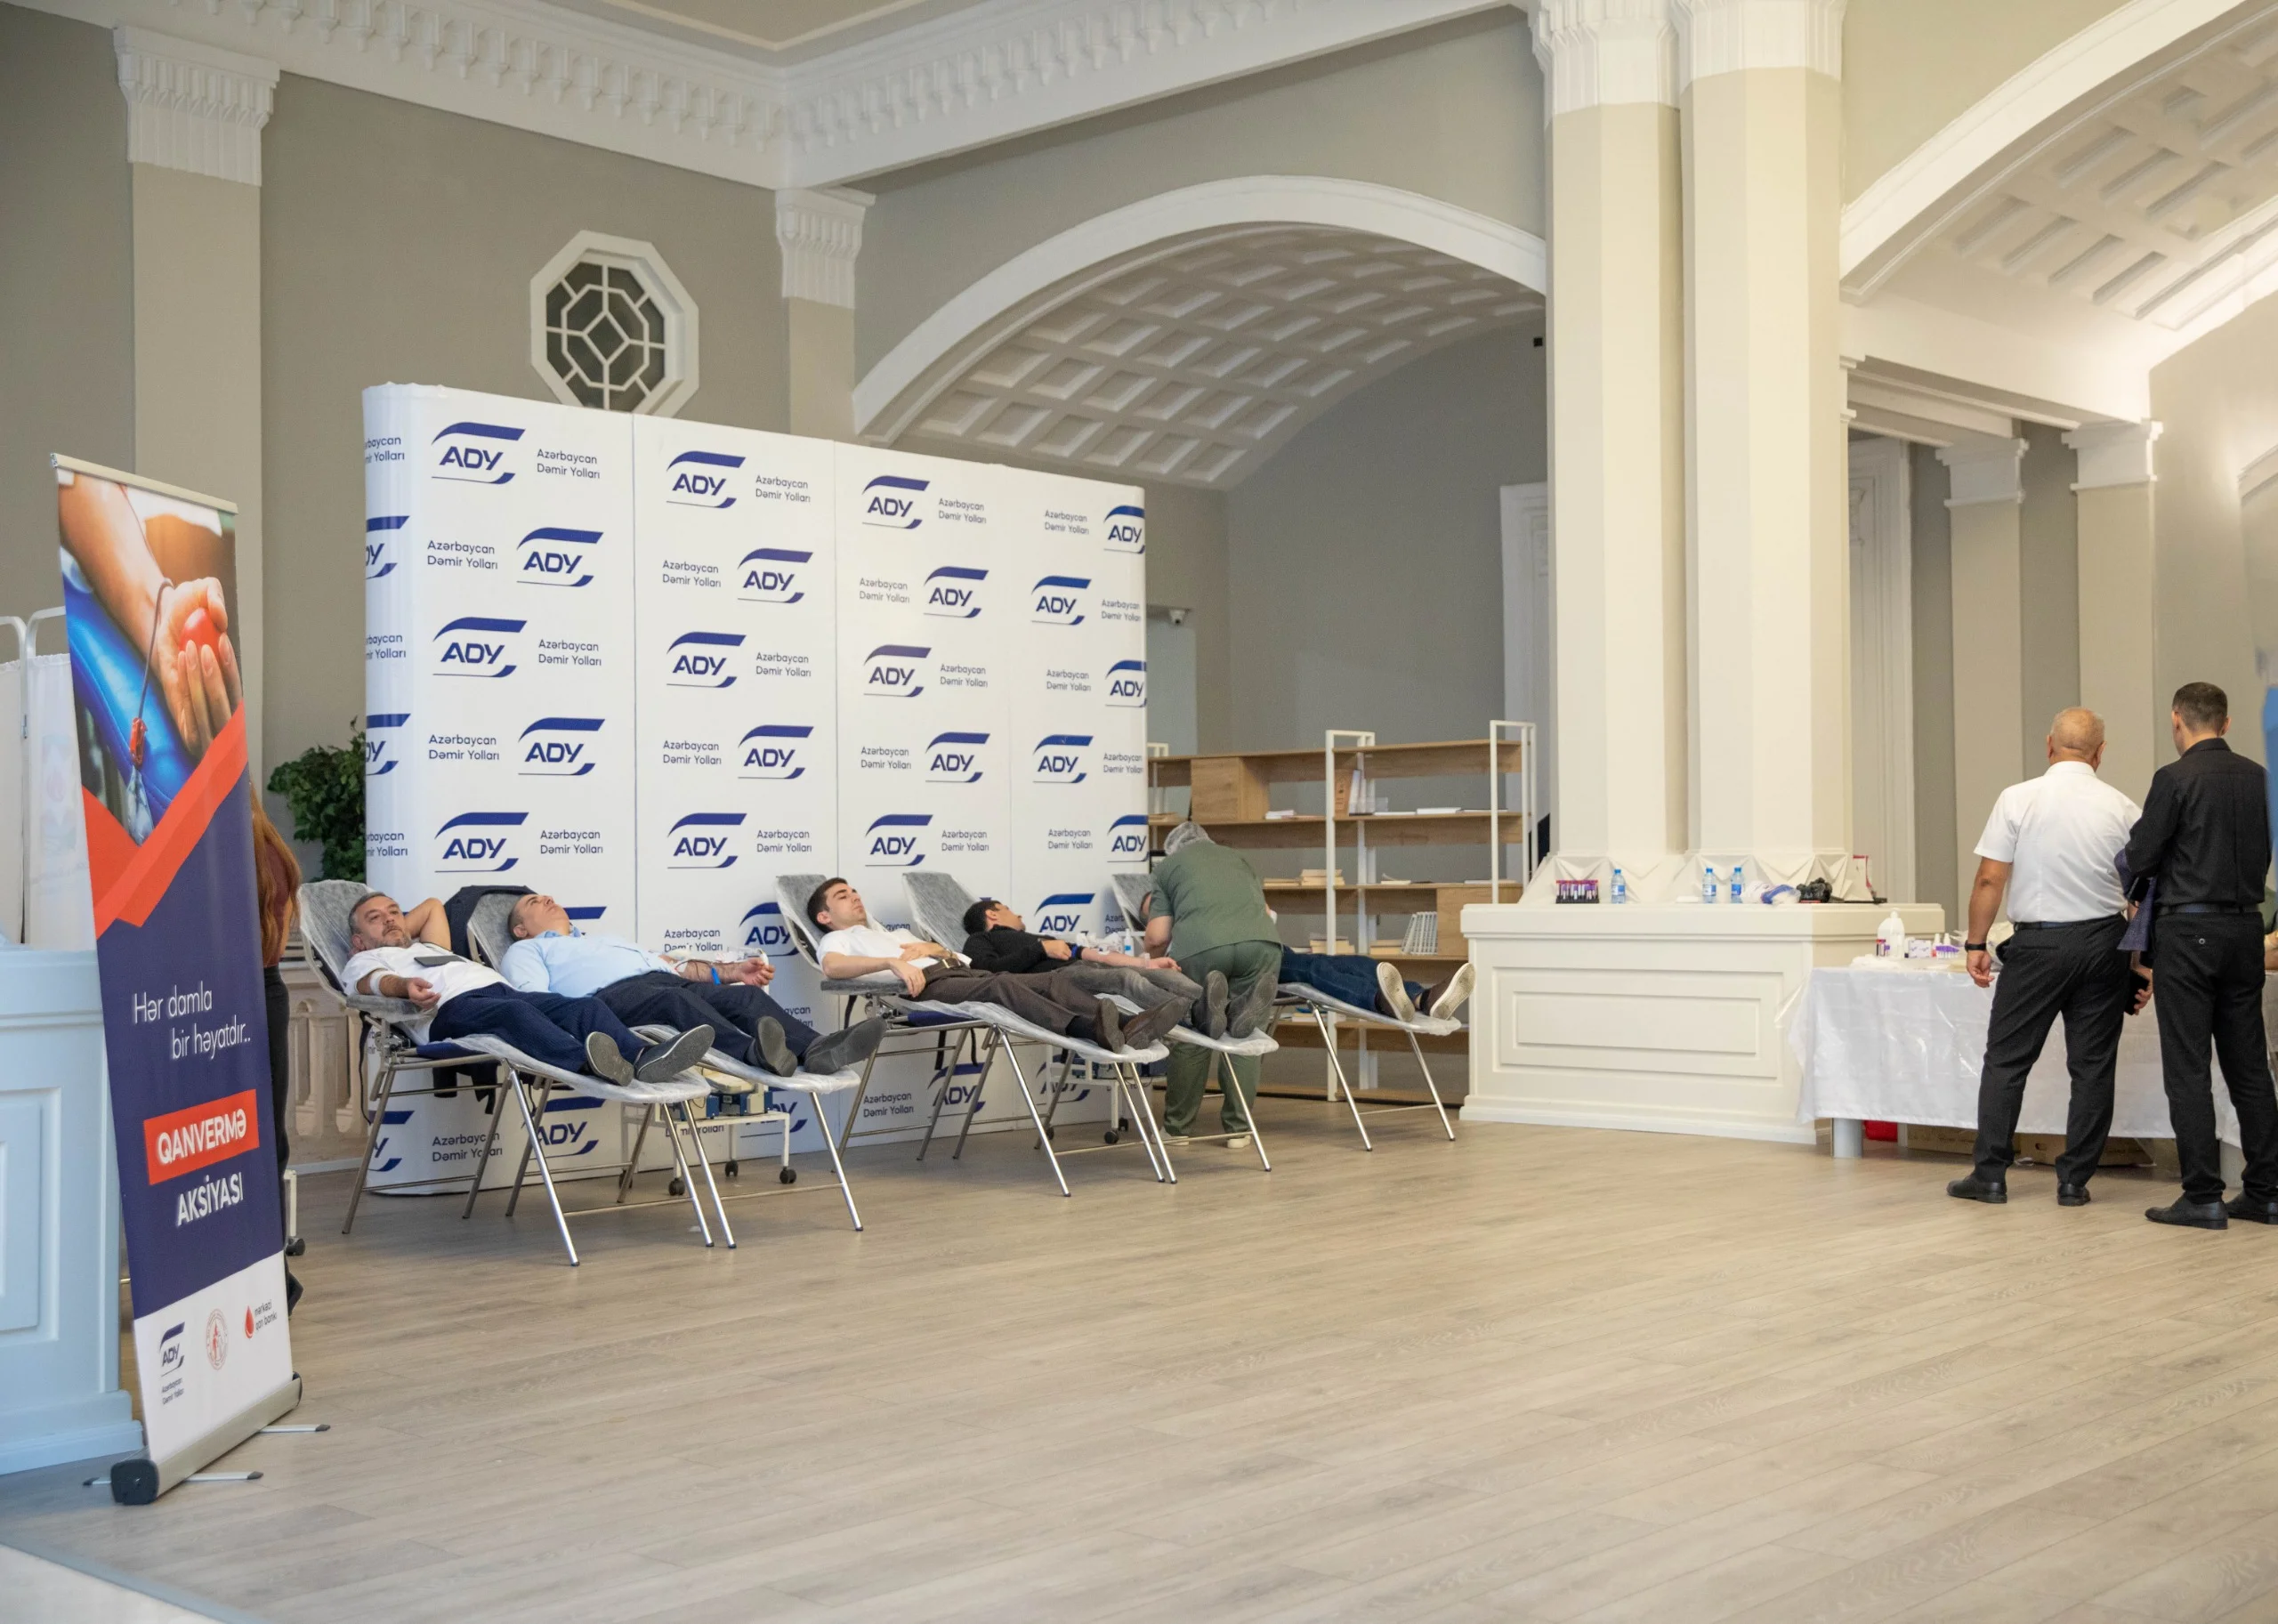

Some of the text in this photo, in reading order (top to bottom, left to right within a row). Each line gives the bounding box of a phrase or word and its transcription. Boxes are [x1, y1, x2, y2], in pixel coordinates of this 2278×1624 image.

[439, 446, 504, 471] ADY
[537, 448, 597, 465] Azərbaycan
[537, 463, 600, 479] Dəmir Yolları
[672, 473, 727, 496] ADY
[755, 475, 808, 489] Azərbaycan
[755, 489, 811, 502] Dəmir Yolları
[867, 497, 913, 518] ADY
[939, 498, 984, 511] Azərbaycan
[939, 510, 986, 523] Dəmir Yolları
[1045, 510, 1086, 522] Azərbaycan
[1045, 521, 1089, 534] Dəmir Yolları
[1108, 525, 1143, 543] ADY
[427, 540, 495, 555] Azərbaycan
[427, 555, 497, 570] Dəmir Yolları
[523, 551, 583, 574] ADY
[662, 560, 718, 574] Azərbaycan
[663, 574, 721, 587] Dəmir Yolları
[742, 570, 795, 591] ADY
[860, 578, 908, 591] Azərbaycan
[860, 591, 909, 602] Dəmir Yolları
[928, 587, 973, 607] ADY
[1036, 595, 1077, 614] ADY
[538, 639, 599, 652] Azərbaycan
[440, 642, 505, 665] ADY
[538, 654, 602, 666] Dəmir Yolları
[756, 652, 809, 665] Azərbaycan
[672, 655, 727, 676] ADY
[756, 666, 811, 676] Dəmir Yolları
[941, 664, 986, 675] Azərbaycan
[868, 667, 916, 686] ADY
[940, 676, 988, 687] Dəmir Yolları
[1046, 669, 1089, 680] Azərbaycan
[1046, 681, 1091, 691] Dəmir Yolları
[1110, 680, 1143, 698] ADY
[429, 734, 497, 747] Azərbaycan
[663, 740, 719, 753] Azərbaycan
[429, 749, 499, 760] Dəmir Yolları
[524, 742, 585, 764] ADY
[663, 755, 722, 764] Dəmir Yolları
[743, 747, 796, 768] ADY
[861, 747, 909, 758] Azərbaycan
[861, 759, 911, 769] Dəmir Yolları
[930, 754, 974, 772] ADY
[1037, 755, 1078, 773] ADY
[540, 829, 600, 842] Azərbaycan
[757, 829, 810, 841] Azərbaycan
[941, 830, 987, 840] Azərbaycan
[1048, 828, 1091, 838] Azərbaycan
[442, 838, 507, 860] ADY
[540, 844, 603, 854] Dəmir Yolları
[673, 837, 728, 857] ADY
[757, 843, 812, 852] Dəmir Yolları
[869, 836, 917, 855] ADY
[941, 843, 989, 852] Dəmir Yolları
[1048, 841, 1093, 849] Dəmir Yolları
[1111, 835, 1147, 852] ADY
[1039, 915, 1081, 933] ADY
[664, 928, 720, 940] Azərbaycan
[133, 980, 213, 1024] Hər damla
[171, 1027, 190, 1059] bir
[863, 1093, 912, 1103] Azərbaycan
[863, 1104, 914, 1118] Dəmir Yolları
[157, 1108, 247, 1165] QANVERMƏ
[432, 1132, 500, 1147] Azərbaycn
[432, 1148, 503, 1162] Dəmir Yoarı
[176, 1171, 244, 1227] AKSİYASI
[161, 1342, 181, 1368] ADY
